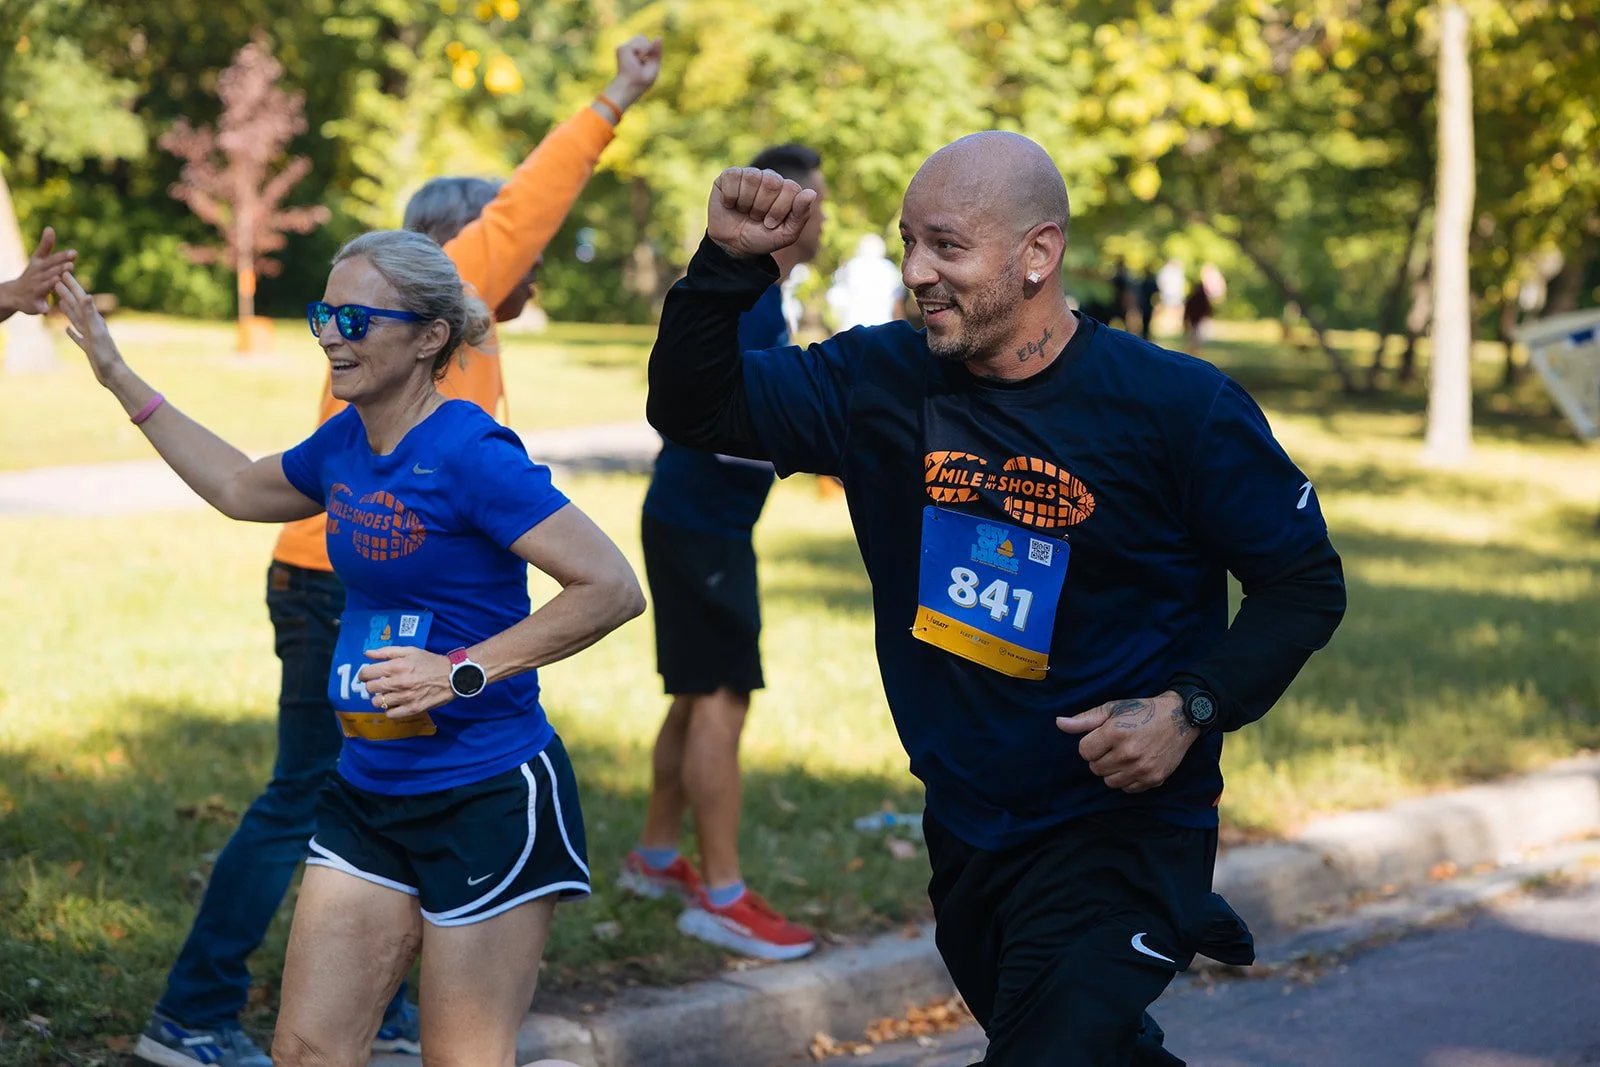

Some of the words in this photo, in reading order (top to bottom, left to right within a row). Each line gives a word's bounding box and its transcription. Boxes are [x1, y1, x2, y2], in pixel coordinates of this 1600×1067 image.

[938, 468, 984, 487] MILE
[984, 482, 997, 490] MY
[997, 476, 1057, 499] SHOES
[352, 508, 391, 531] SHOES
[947, 566, 1034, 632] 841
[337, 663, 383, 700] 14
